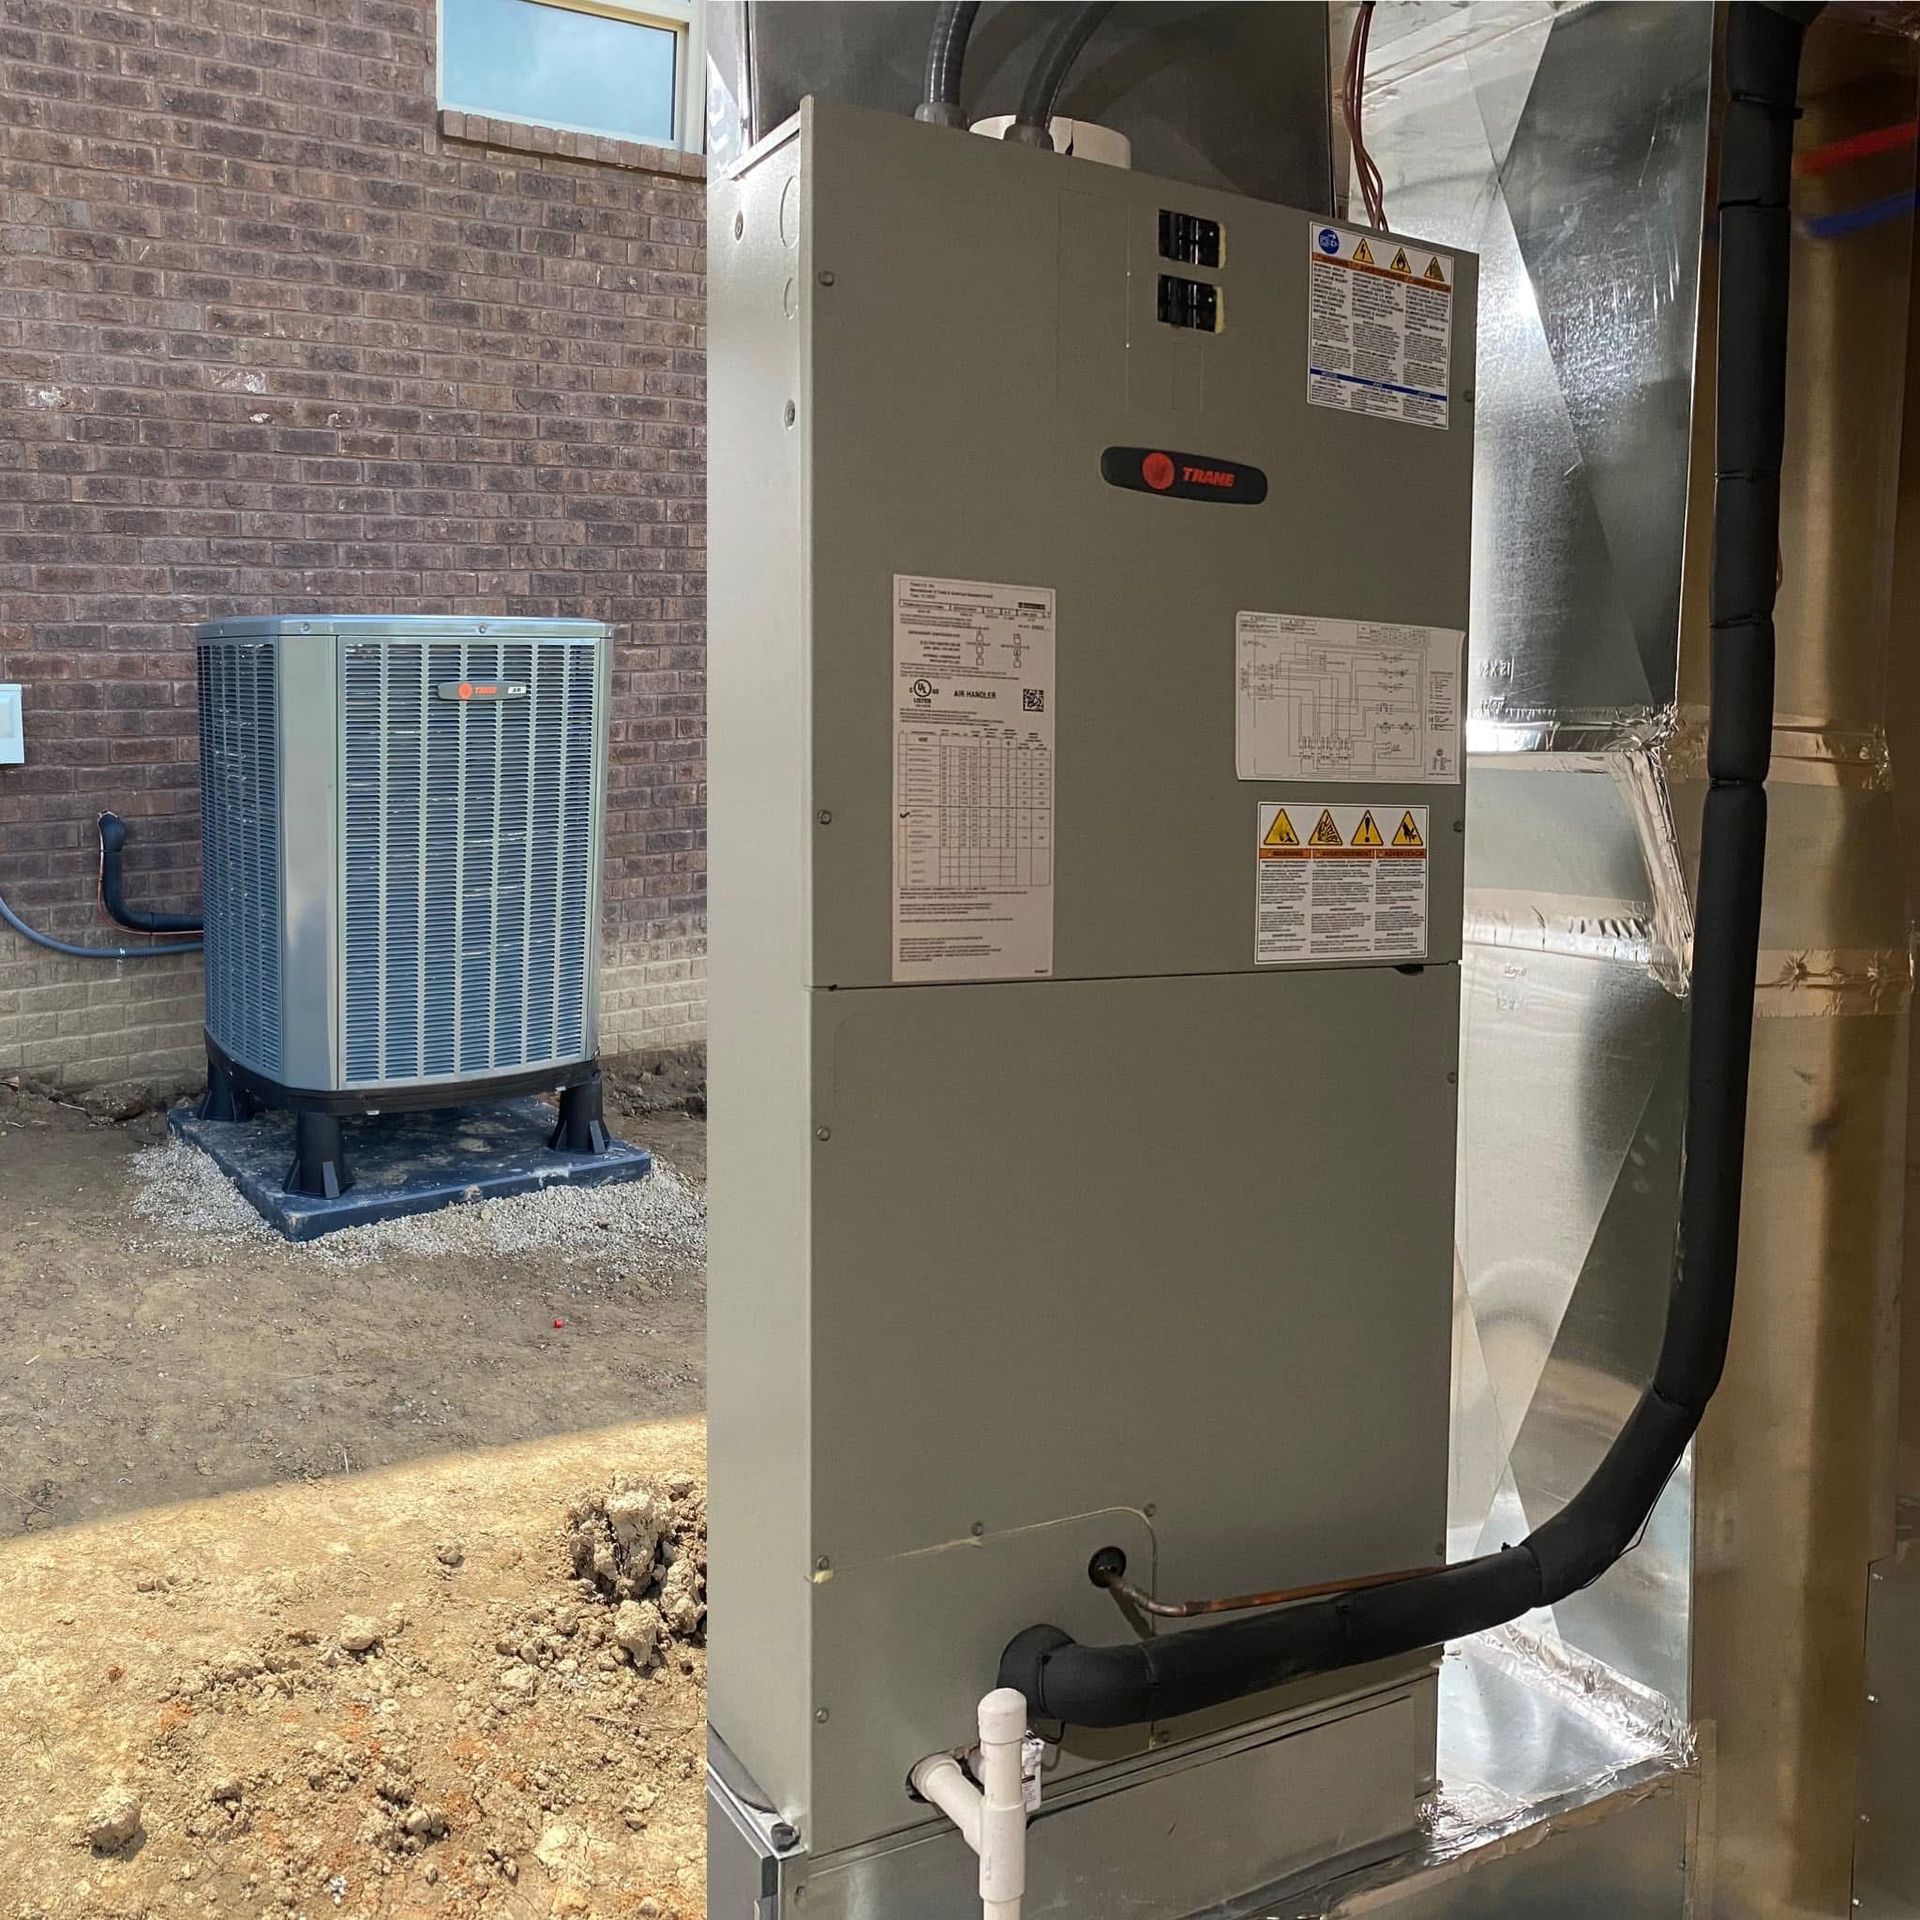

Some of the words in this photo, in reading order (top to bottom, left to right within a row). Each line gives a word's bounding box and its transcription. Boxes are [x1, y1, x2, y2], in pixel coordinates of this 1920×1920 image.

[1183, 466, 1235, 487] TRANE
[954, 690, 965, 698] AIR
[966, 690, 997, 699] HANDLER
